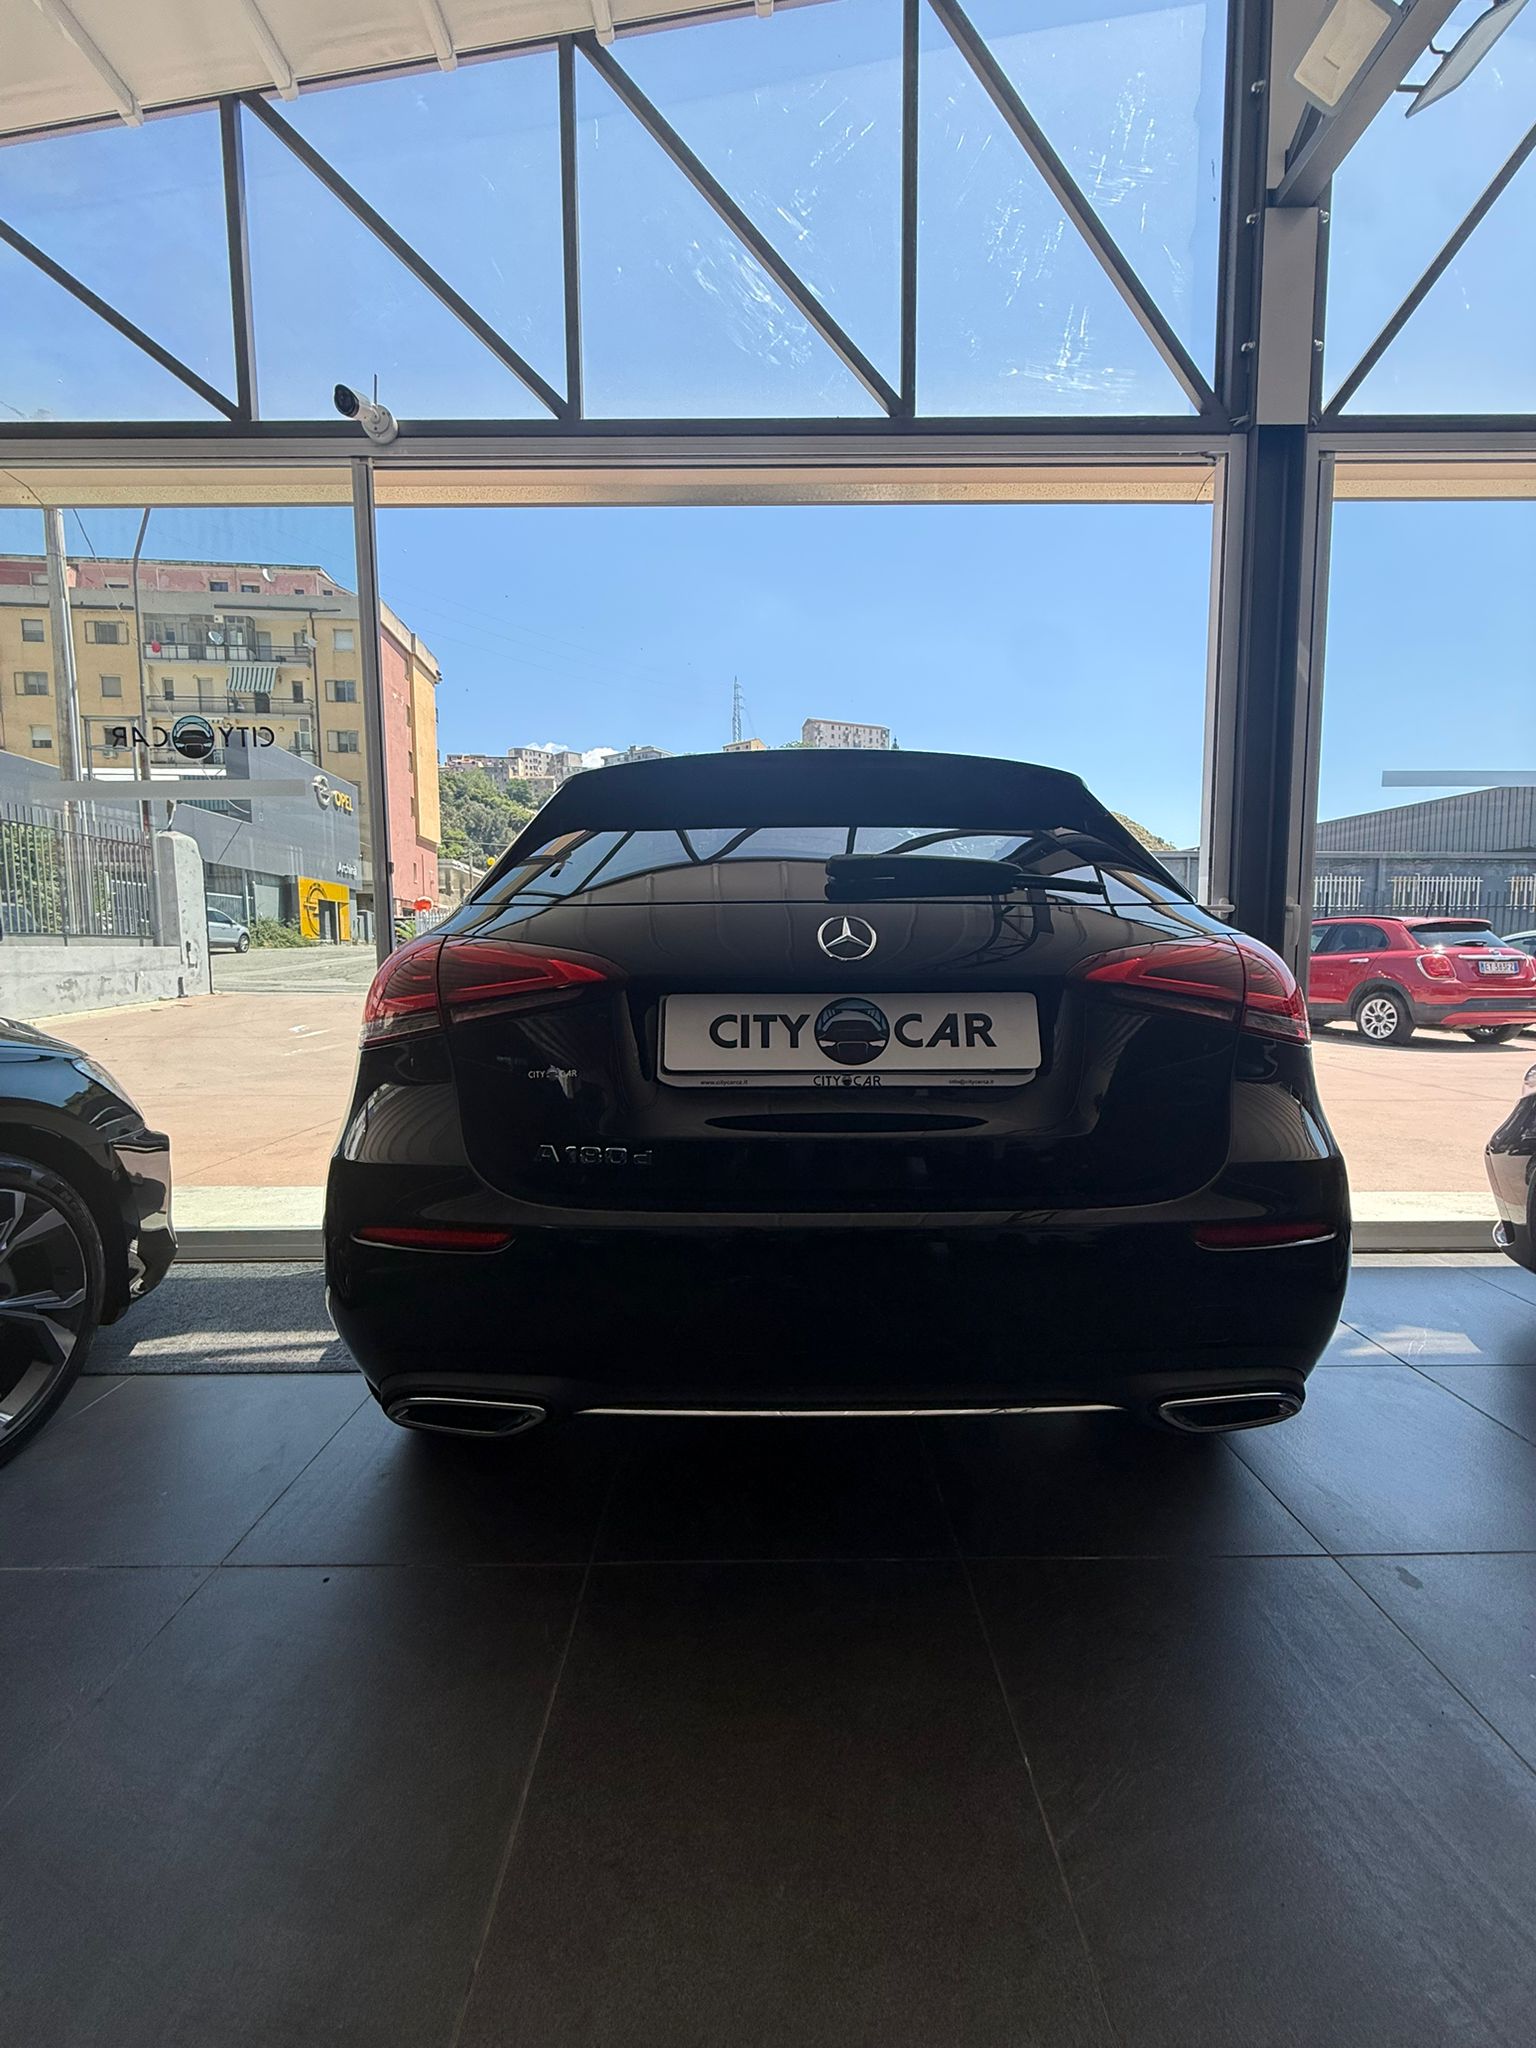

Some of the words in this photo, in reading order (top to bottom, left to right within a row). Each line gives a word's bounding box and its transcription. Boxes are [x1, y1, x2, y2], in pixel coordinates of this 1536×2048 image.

[334, 791, 354, 812] OPEL
[709, 1014, 811, 1049] CITY
[894, 1013, 998, 1048] CAR
[527, 1070, 546, 1079] CITY
[813, 1075, 841, 1087] CITY
[853, 1075, 881, 1087] CAR
[565, 1146, 628, 1164] 180
